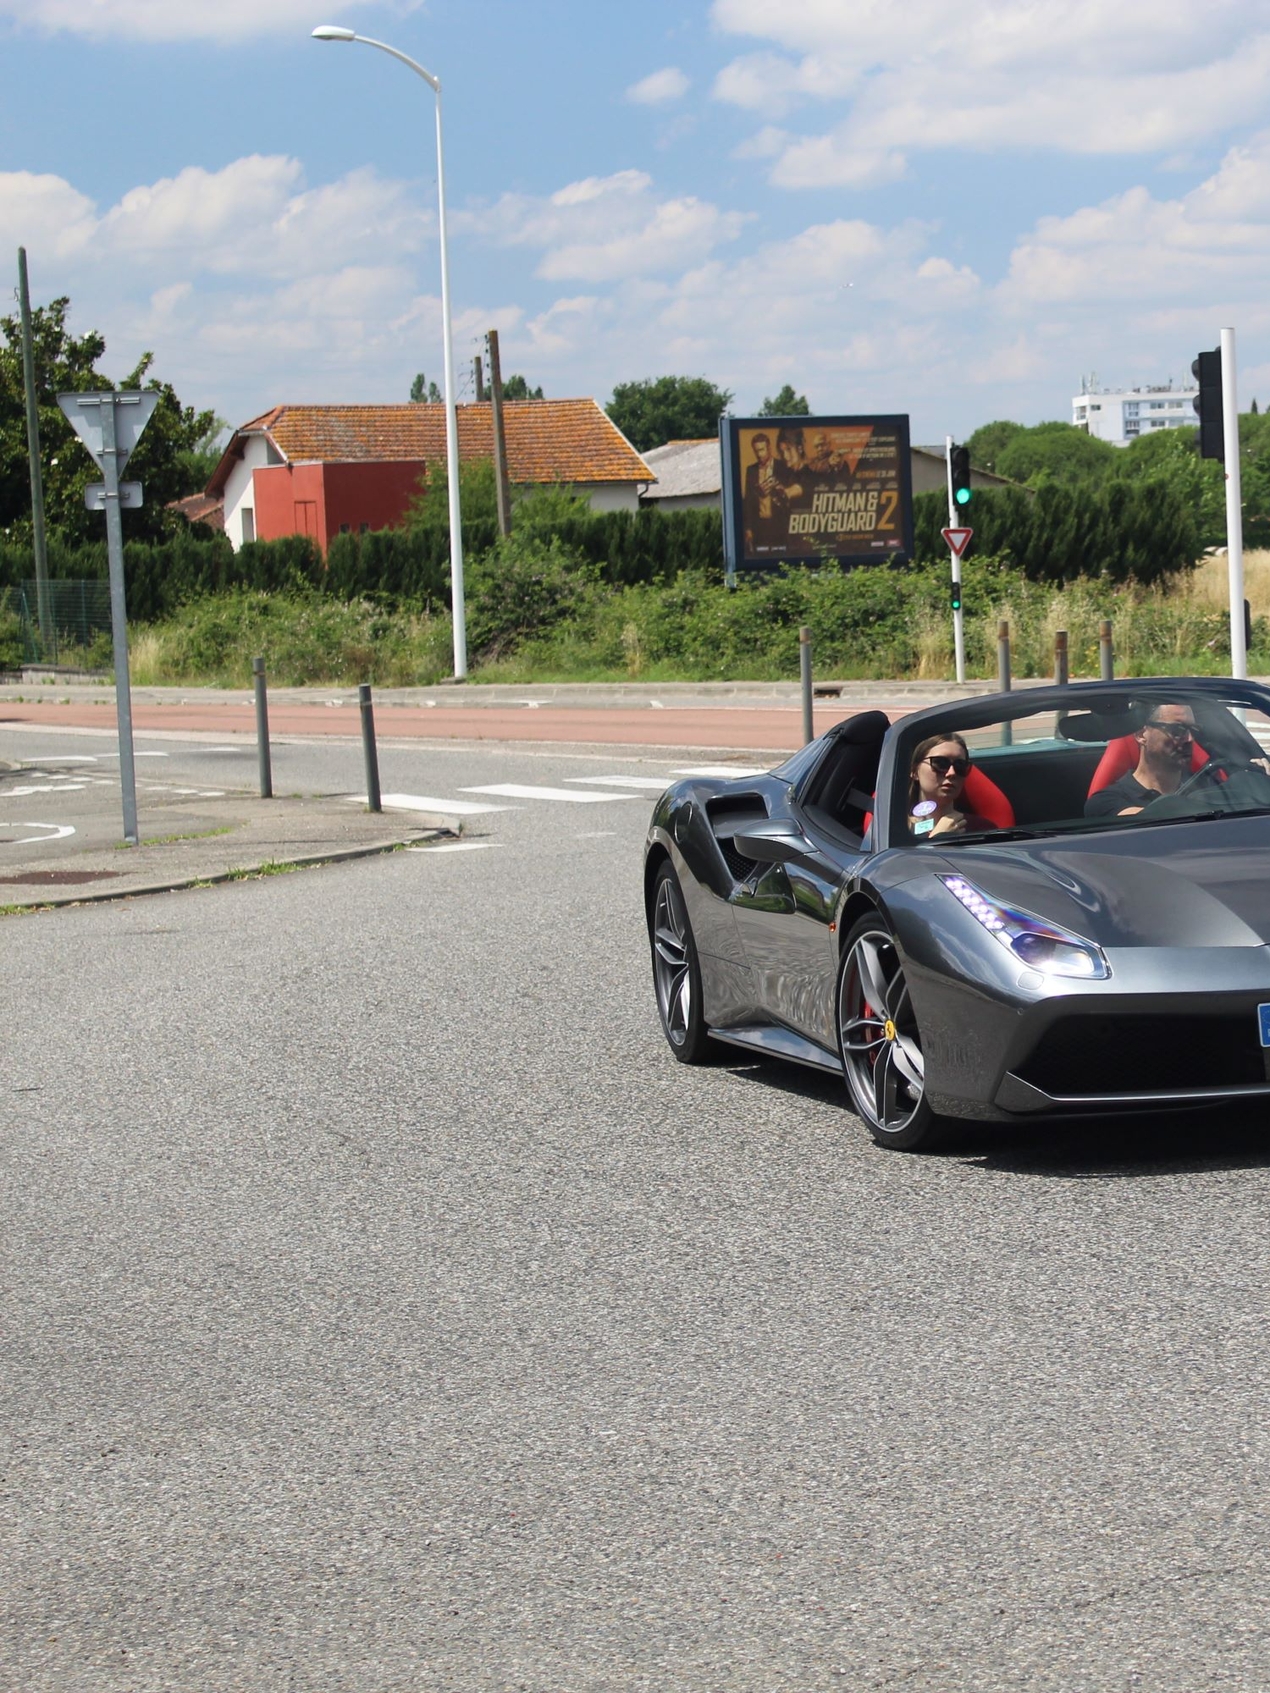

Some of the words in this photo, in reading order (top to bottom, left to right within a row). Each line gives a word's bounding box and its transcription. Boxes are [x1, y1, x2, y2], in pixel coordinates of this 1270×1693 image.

[812, 492, 866, 513] HITMAN
[866, 491, 878, 511] &
[877, 490, 899, 530] 2
[788, 511, 876, 534] BODYGUARD
